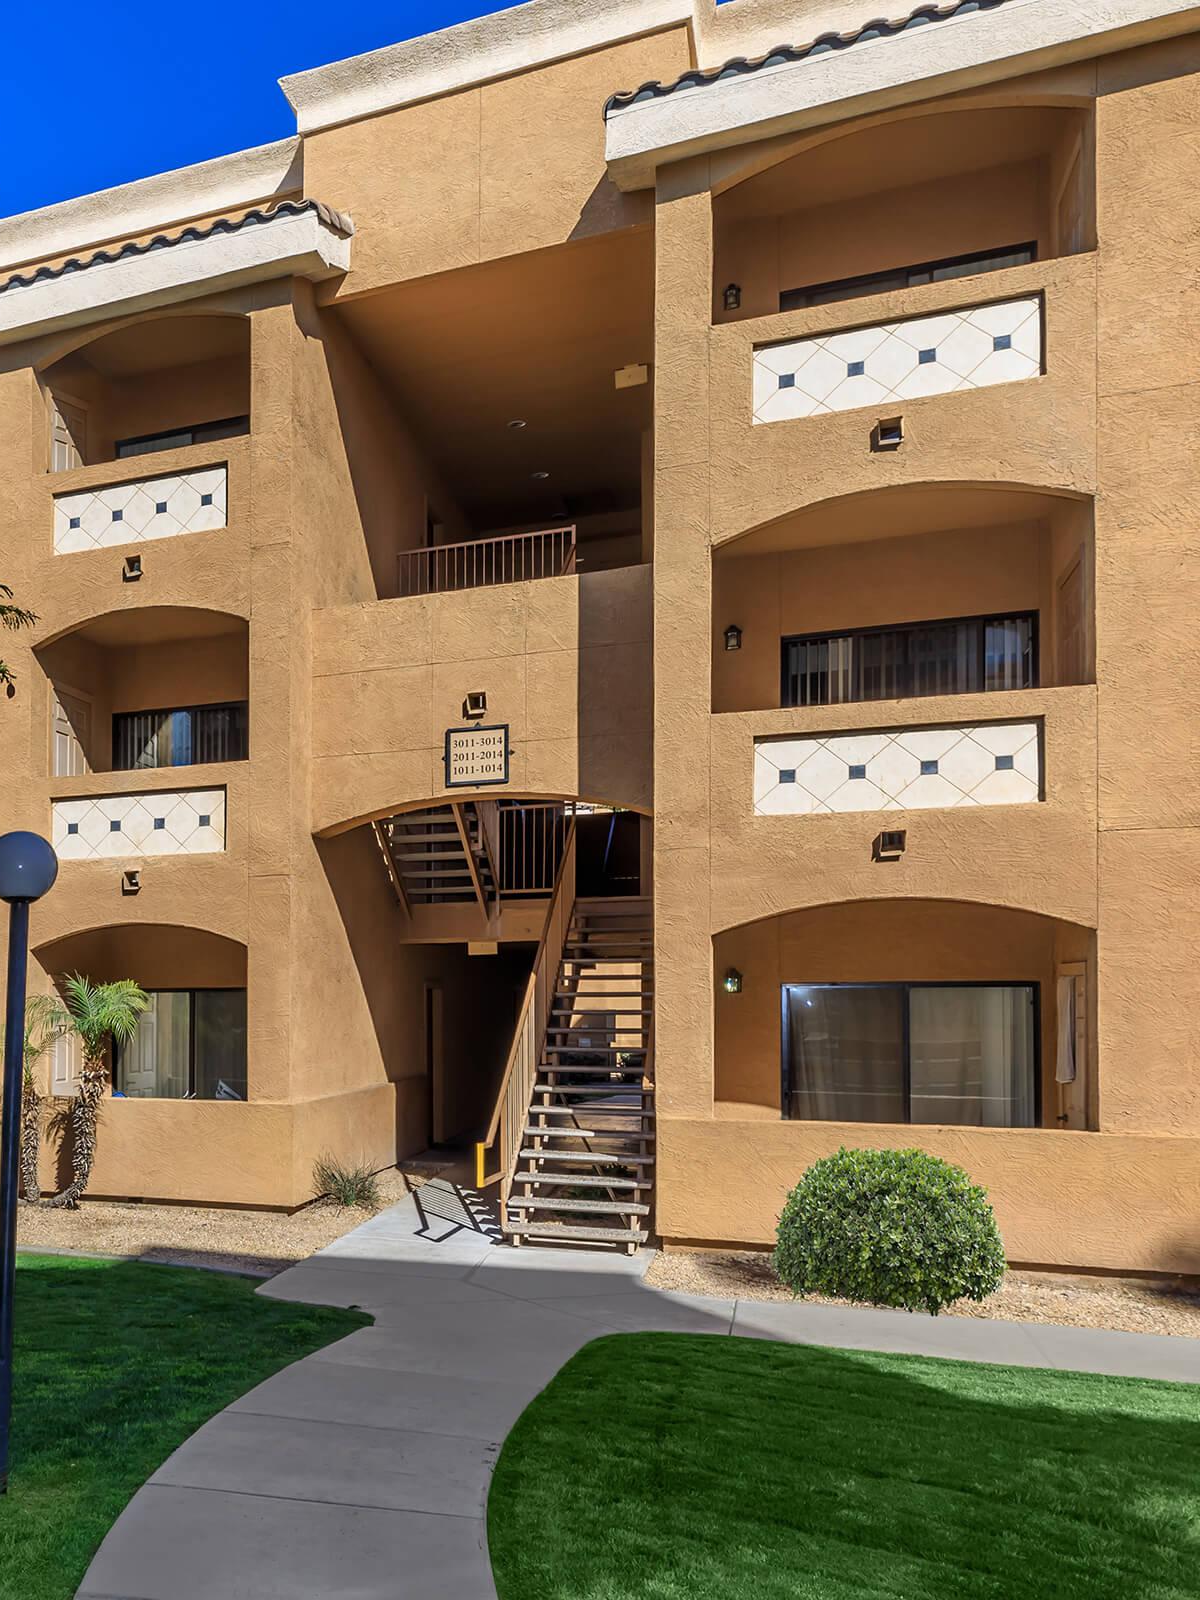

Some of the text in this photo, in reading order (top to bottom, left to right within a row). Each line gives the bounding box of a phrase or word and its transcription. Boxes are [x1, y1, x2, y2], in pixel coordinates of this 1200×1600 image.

[453, 737, 502, 748] 3011-3014
[453, 750, 502, 761] 2011-2014
[453, 764, 502, 775] 1011-1014
